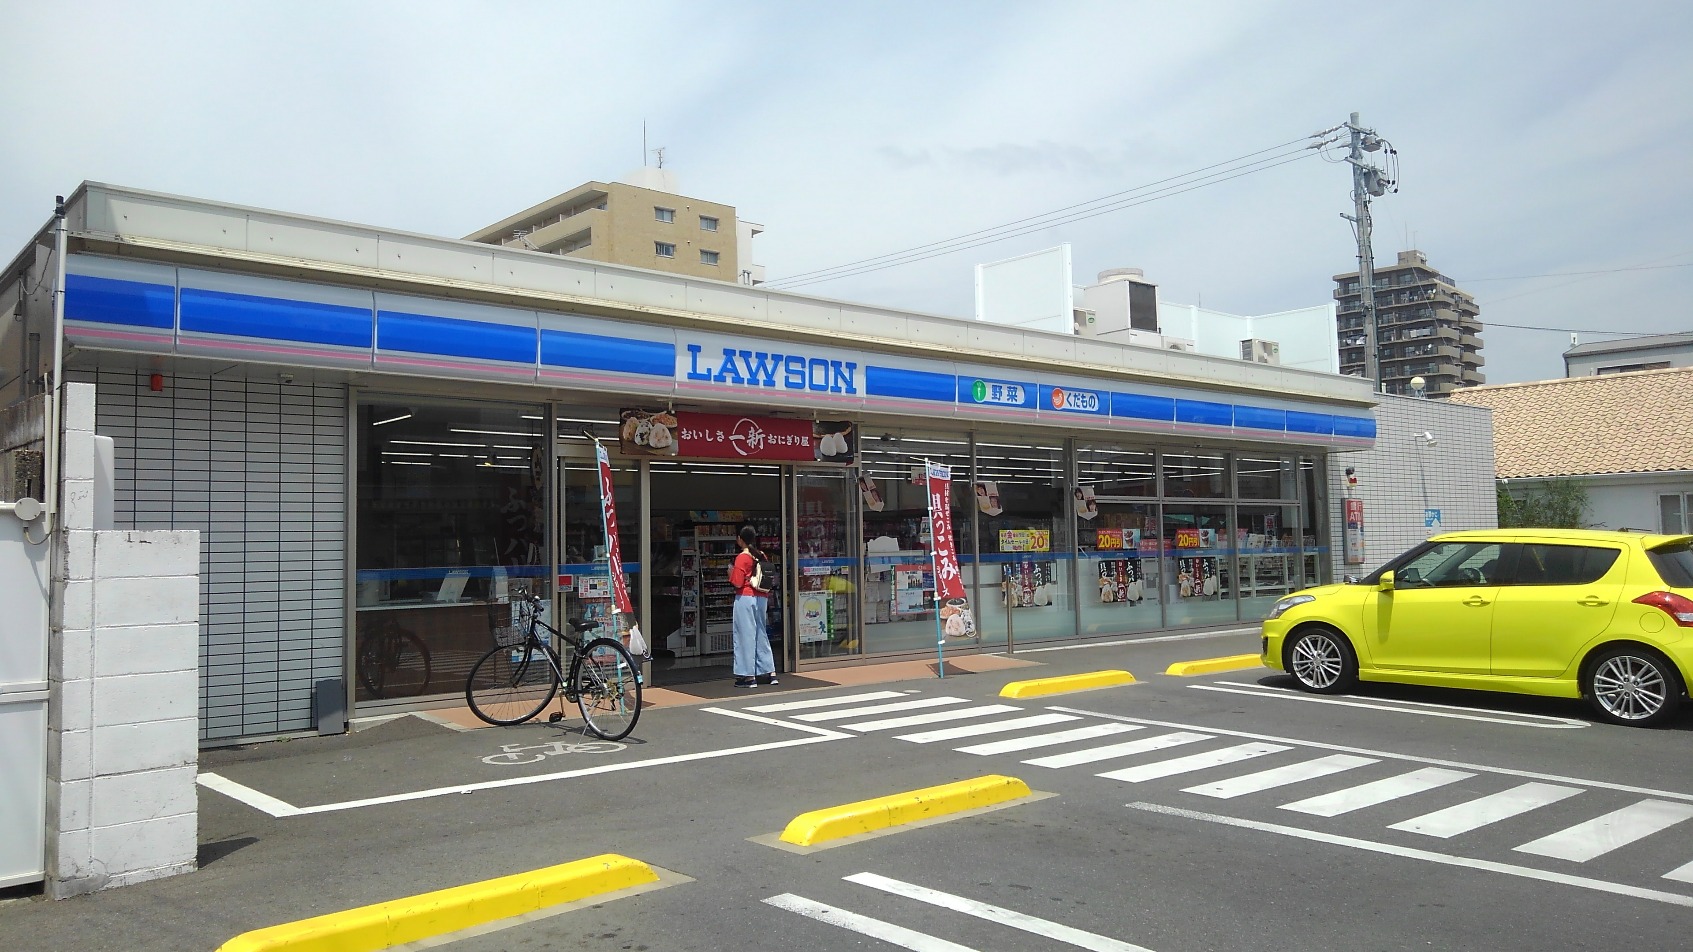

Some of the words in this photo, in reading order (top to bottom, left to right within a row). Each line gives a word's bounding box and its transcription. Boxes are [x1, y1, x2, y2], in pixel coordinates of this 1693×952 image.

[687, 344, 857, 394] LAWSON
[991, 384, 1018, 402] 野菜
[1066, 391, 1096, 409] くだもの
